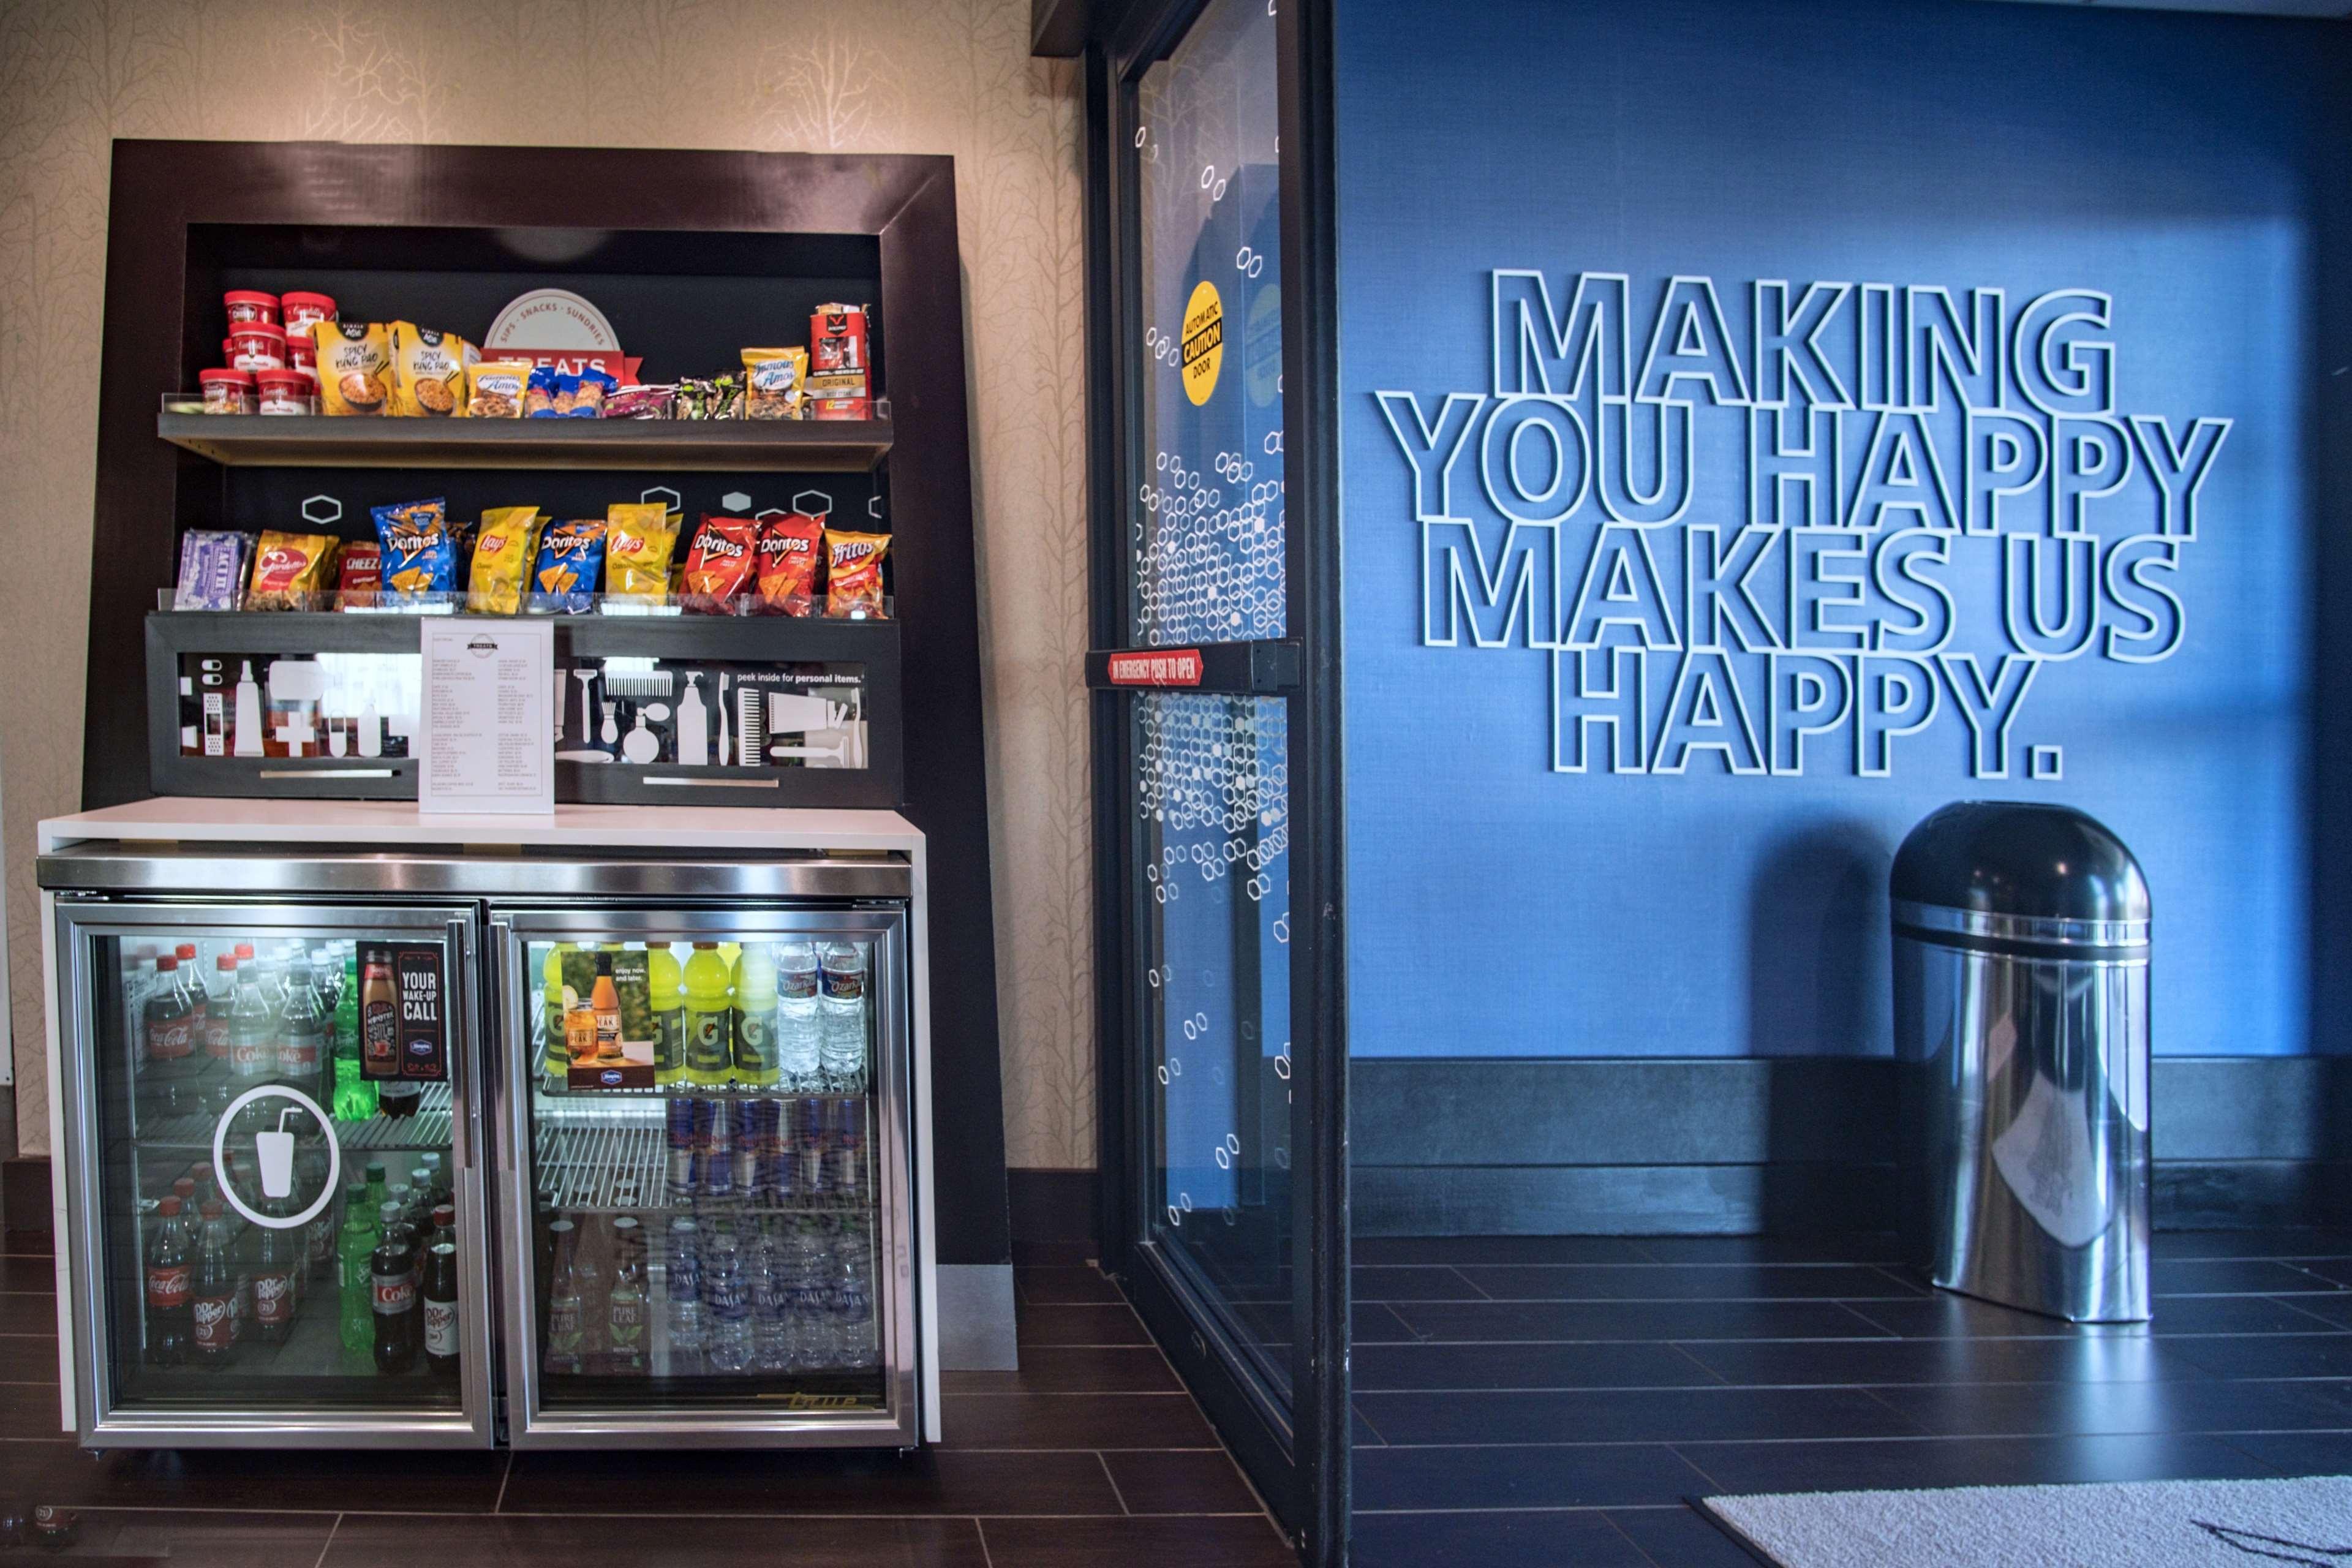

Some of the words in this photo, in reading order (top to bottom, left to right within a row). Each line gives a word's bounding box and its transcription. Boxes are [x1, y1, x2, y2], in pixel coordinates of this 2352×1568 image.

[500, 322, 516, 342] SIPS
[521, 303, 558, 319] SNACKS
[565, 307, 605, 345] SUNDRIES
[1185, 301, 1218, 336] AUTOMATIC
[344, 344, 368, 357] SPICY
[1183, 321, 1221, 364] CAUTION
[1491, 268, 2117, 418] MAKING
[336, 357, 358, 368] KUNG
[361, 353, 379, 366] PAO
[421, 350, 441, 361] SPICY
[413, 361, 432, 371] KUNG
[435, 361, 451, 371] PAO
[498, 356, 606, 377] EATS
[754, 360, 794, 377] Famous
[1193, 357, 1212, 379] DOOR
[478, 374, 520, 383] Famous
[485, 380, 519, 391] Amos
[760, 371, 795, 387] Amos
[822, 377, 855, 387] ORIGINAL
[1374, 390, 1695, 529] YOU
[1747, 404, 2234, 543] HAPPY
[386, 533, 439, 552] Doritos
[540, 535, 592, 551] Doritos
[695, 533, 744, 557] Doritos
[760, 537, 809, 553] Doritos
[346, 557, 379, 570] CHEEZ
[832, 542, 873, 568] Fritos
[1421, 518, 1958, 657] MAKES
[2004, 530, 2187, 665] US
[1112, 660, 1119, 679] IN
[1119, 659, 1150, 679] EMERGENCY
[1151, 658, 1167, 679] PUSH
[1167, 658, 1177, 679] TO
[1177, 657, 1195, 679] OPEN
[737, 673, 756, 682] peek
[758, 673, 780, 682] inside
[782, 673, 793, 682] for
[796, 674, 832, 684] personal
[834, 674, 861, 683] items.
[1550, 644, 2064, 782] HAPPY.
[402, 971, 436, 990] YOUR
[402, 990, 437, 1001] WAKE-UP
[403, 1001, 437, 1021] CALL
[697, 1016, 719, 1046] G
[741, 1016, 764, 1046] G
[279, 1046, 301, 1063] oke
[674, 1272, 700, 1286] DASA
[382, 1287, 412, 1303] Coke
[714, 1292, 745, 1308] DASA
